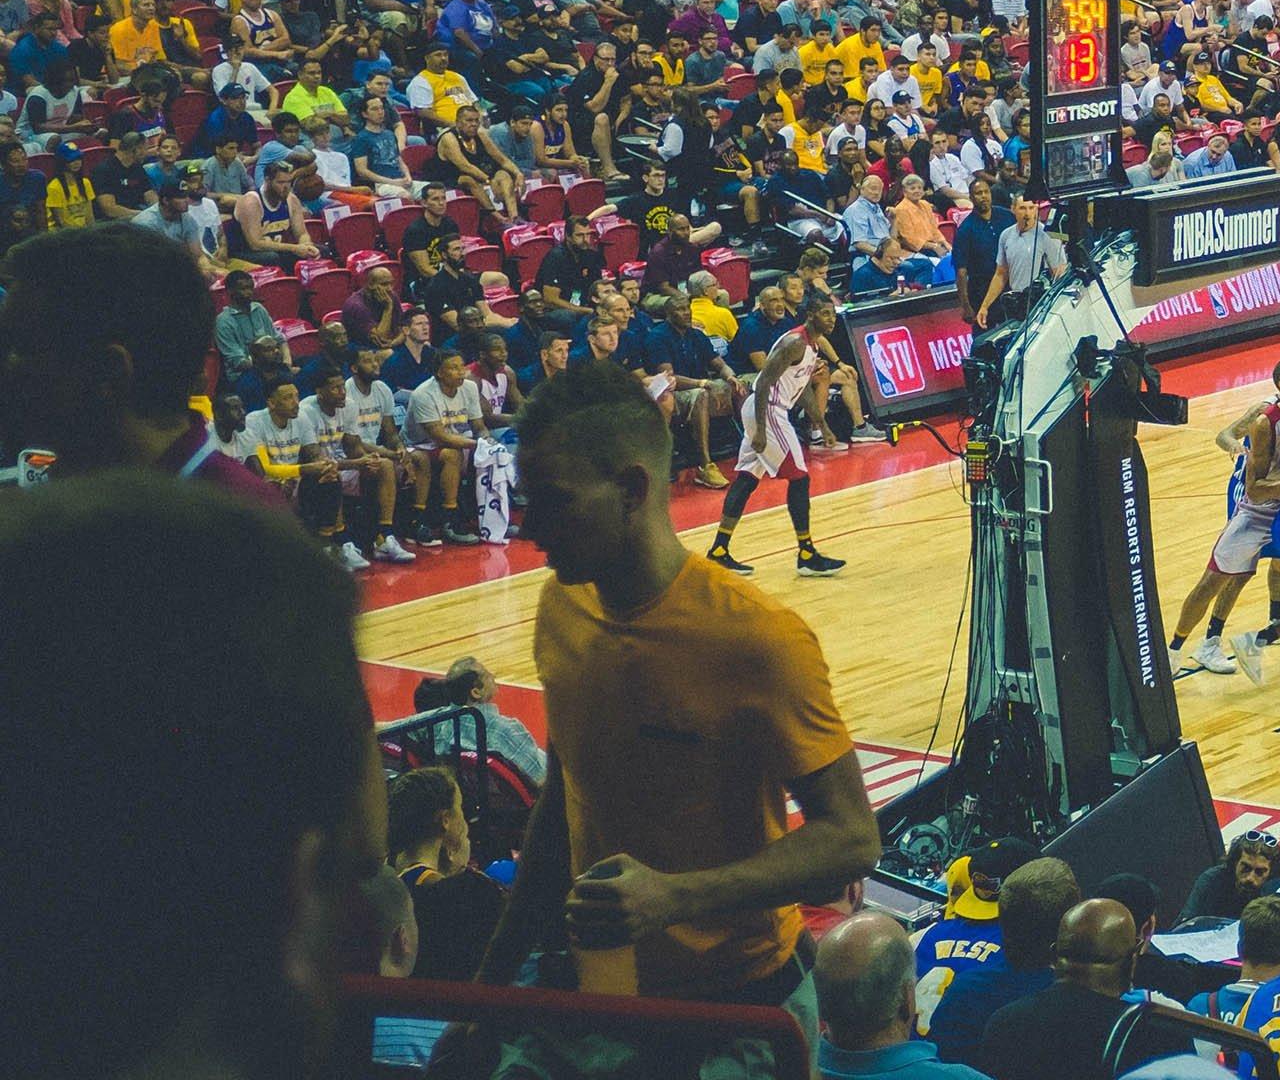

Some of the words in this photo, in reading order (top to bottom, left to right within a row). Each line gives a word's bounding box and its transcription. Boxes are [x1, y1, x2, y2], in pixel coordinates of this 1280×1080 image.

[1062, 0, 1105, 33] 7:54
[1070, 37, 1096, 83] 13
[1067, 100, 1118, 122] TISSOT
[1173, 207, 1279, 261] #NBASummer
[887, 340, 915, 381] TV
[1121, 457, 1134, 494] MGM
[1124, 497, 1141, 565] RESORTS
[1131, 568, 1152, 687] INTERNATIONAL
[935, 939, 1001, 962] WEST
